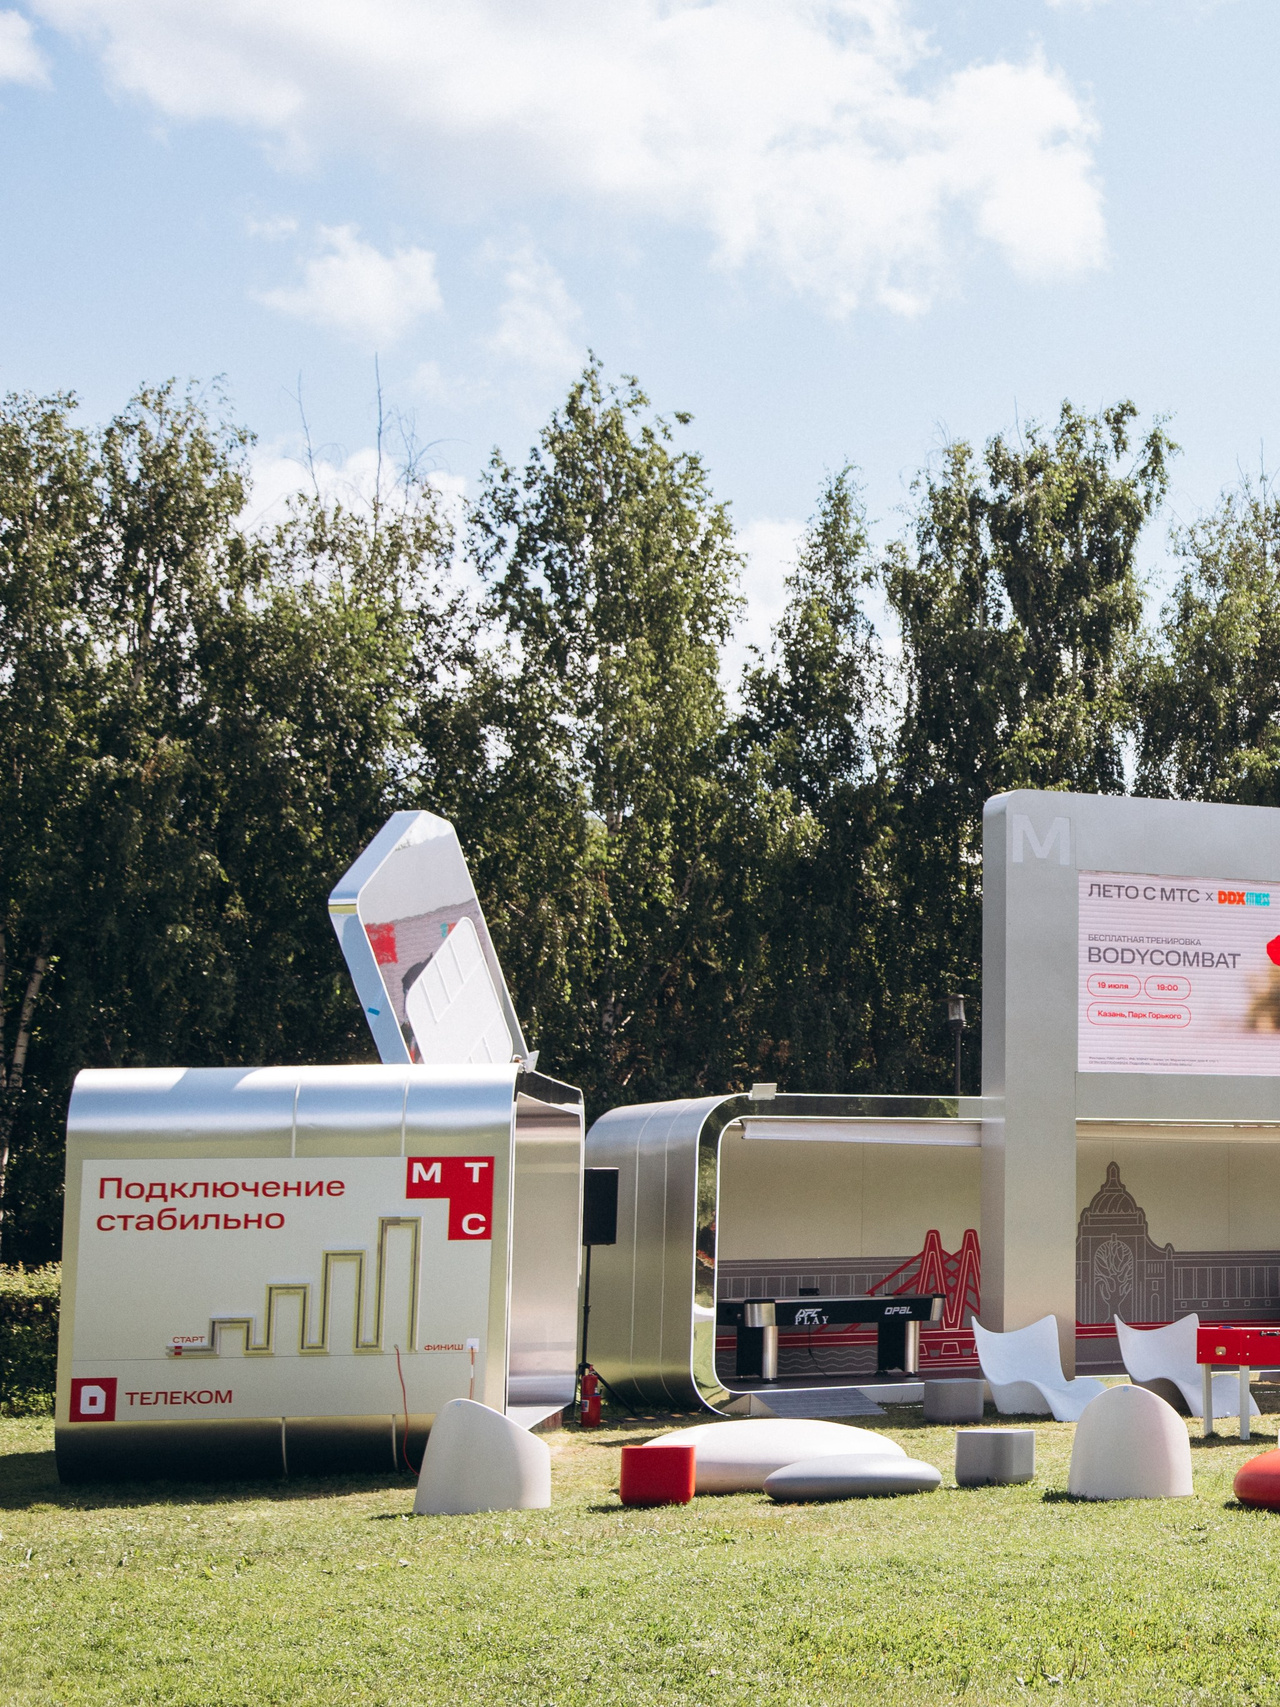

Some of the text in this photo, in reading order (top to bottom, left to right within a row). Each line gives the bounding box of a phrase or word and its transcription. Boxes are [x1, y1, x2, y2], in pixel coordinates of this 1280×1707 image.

[1088, 883, 1139, 900] ЛЕТО
[1143, 886, 1156, 901] С
[1160, 887, 1200, 903] МТС
[1218, 890, 1246, 906] DDX
[1088, 933, 1202, 946] БЕСПЛАТНАЯ ТРЕНИРОВКА
[1088, 946, 1242, 969] BODYCOMBAT
[1097, 981, 1106, 989] 19
[1097, 1010, 1182, 1020] Казань, Парк Горького
[99, 1177, 345, 1202] Подключение
[96, 1207, 286, 1232] стабильно
[794, 1315, 829, 1325] PLAY
[125, 1390, 233, 1406] ТЕЛЕКОМ
